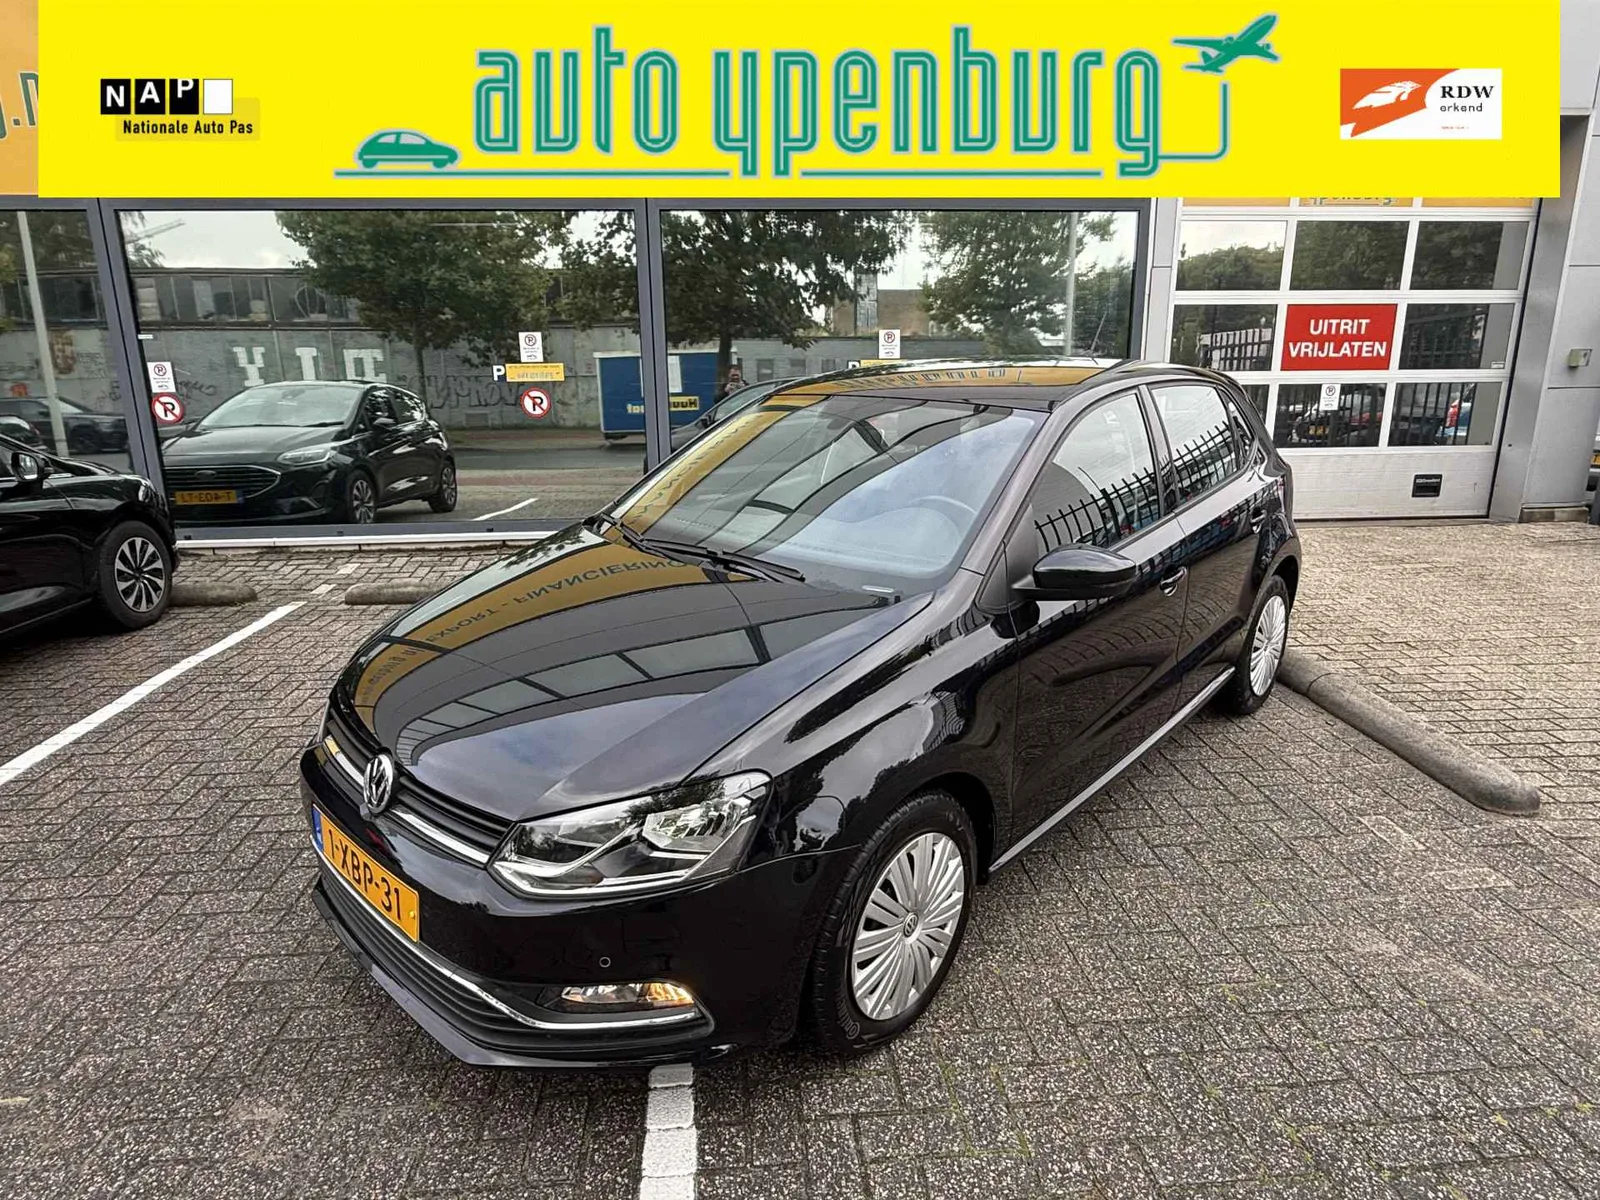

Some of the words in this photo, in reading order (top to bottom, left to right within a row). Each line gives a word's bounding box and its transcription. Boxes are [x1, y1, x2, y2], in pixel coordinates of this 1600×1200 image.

[1309, 319, 1371, 335] UITRIT
[1289, 341, 1387, 358] VRIJLATEN
[328, 829, 402, 921] 1-XBP-31
